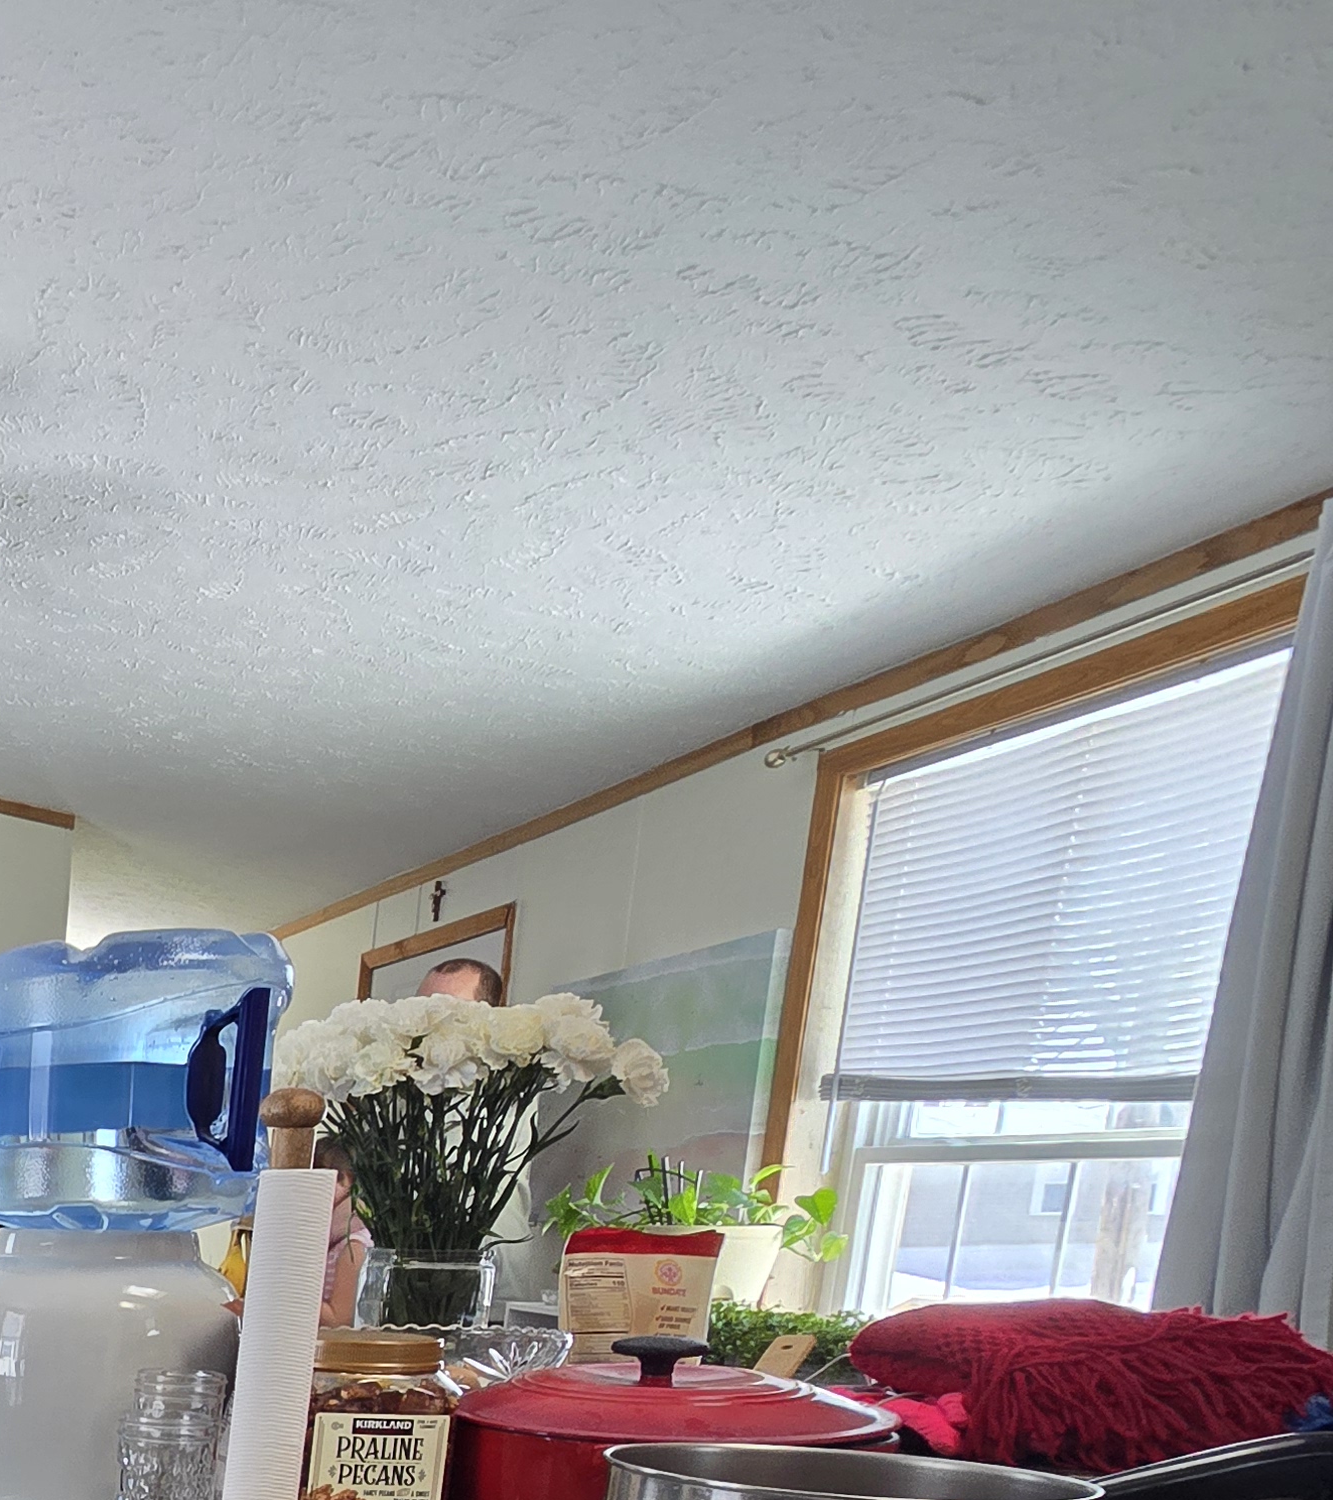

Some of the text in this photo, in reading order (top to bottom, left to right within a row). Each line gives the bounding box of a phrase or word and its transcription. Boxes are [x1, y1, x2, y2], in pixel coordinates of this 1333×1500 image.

[355, 1420, 412, 1430] KIRKLAND
[336, 1435, 424, 1463] PRALINE
[337, 1463, 416, 1486] PECANS
